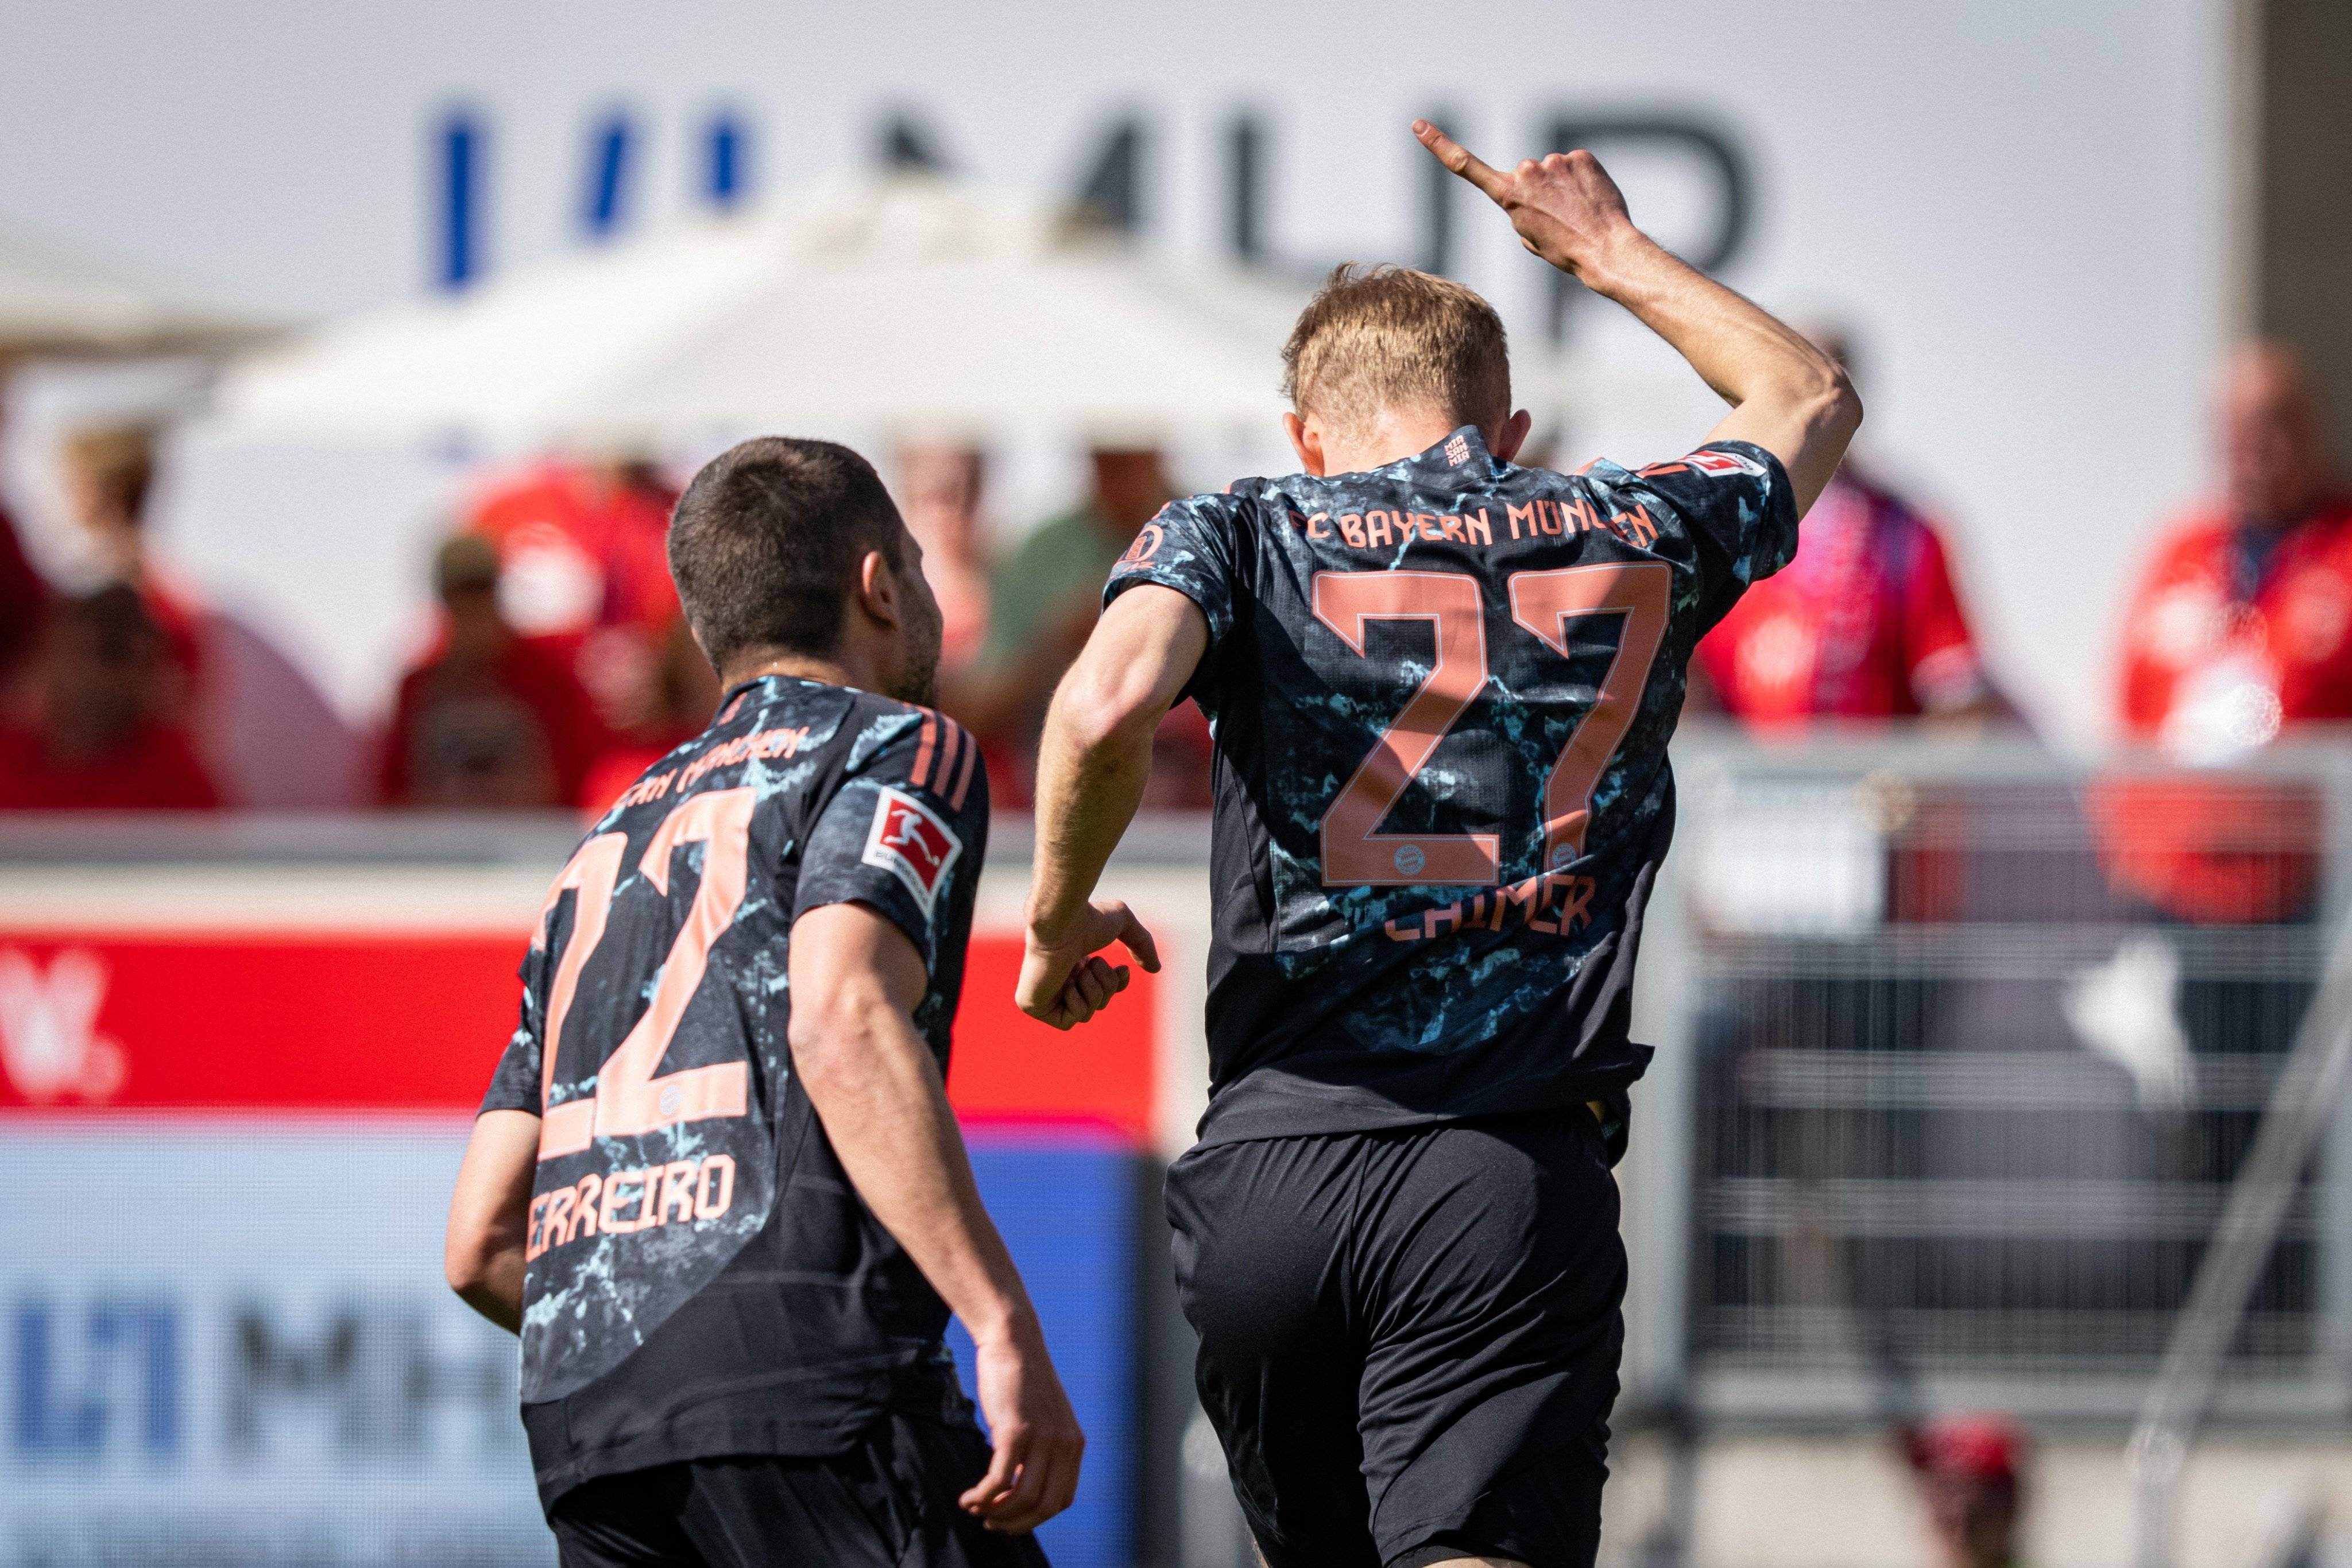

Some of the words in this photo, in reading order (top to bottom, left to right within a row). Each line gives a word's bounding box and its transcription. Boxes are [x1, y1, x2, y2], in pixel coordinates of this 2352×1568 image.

[1444, 435, 1464, 452] MIA
[1446, 442, 1468, 459] SAN
[1448, 451, 1471, 467] MIA
[1339, 508, 1492, 548] BAYERN
[1312, 562, 1672, 886] 27
[531, 787, 757, 1161] 22
